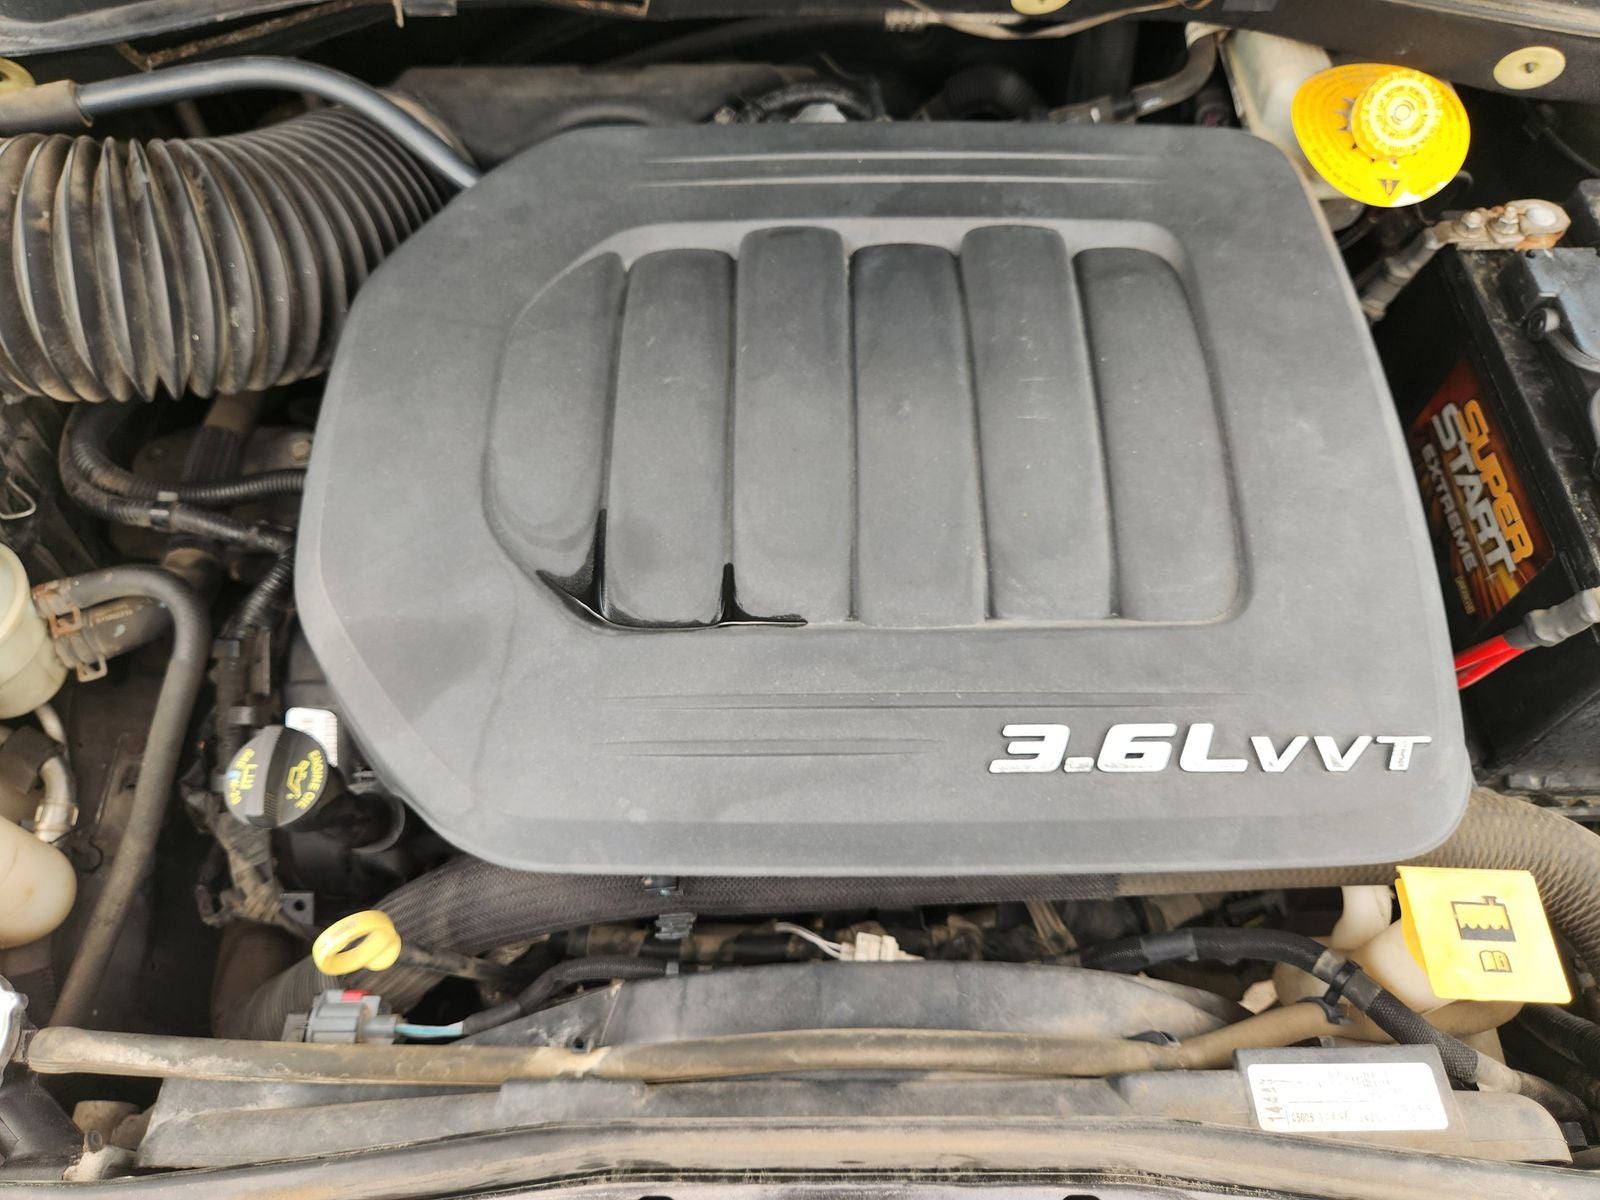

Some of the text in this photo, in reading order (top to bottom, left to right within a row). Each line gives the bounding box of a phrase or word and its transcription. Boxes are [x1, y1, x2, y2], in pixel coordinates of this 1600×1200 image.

[1421, 443, 1479, 574] EXTREME
[1431, 402, 1517, 574] START
[1456, 399, 1535, 564] SUPER
[294, 750, 324, 810] ENGINE OIL
